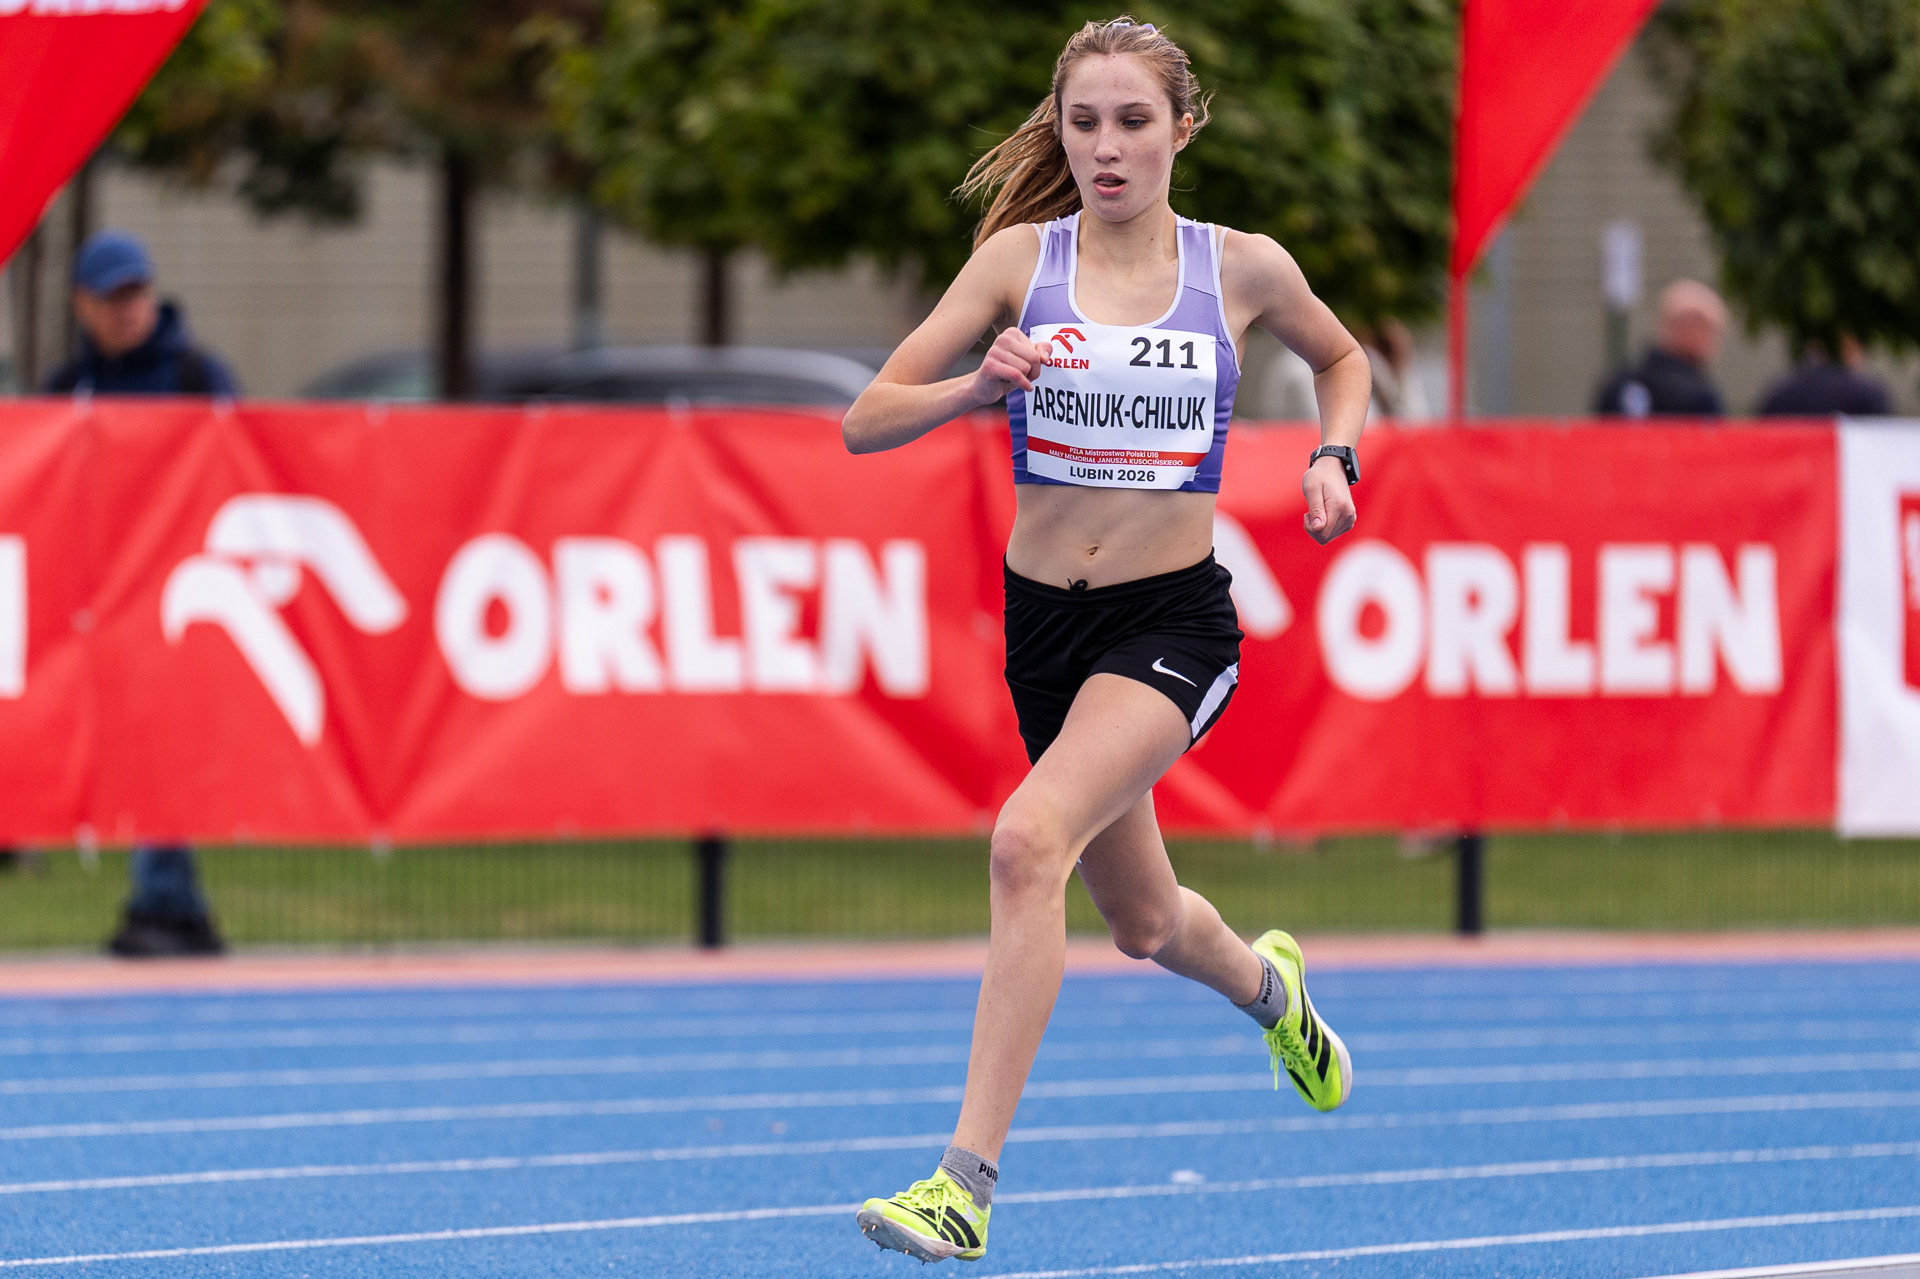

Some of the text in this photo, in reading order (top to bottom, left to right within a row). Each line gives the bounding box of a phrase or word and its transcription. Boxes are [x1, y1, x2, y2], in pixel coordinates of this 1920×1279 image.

[1129, 336, 1198, 370] 211
[1032, 385, 1207, 431] ARSENIUK-CHILUK
[1069, 447, 1084, 455] PZLA
[1085, 449, 1125, 457] Mistrzostwa
[1126, 450, 1146, 458] Polski
[1129, 458, 1183, 466] KUSOCIŃSKIEGO
[1070, 466, 1156, 482] LUBIN 2026
[435, 533, 930, 700] ORLEN
[1317, 538, 1784, 700] ORLEN
[978, 1162, 999, 1183] PUM
